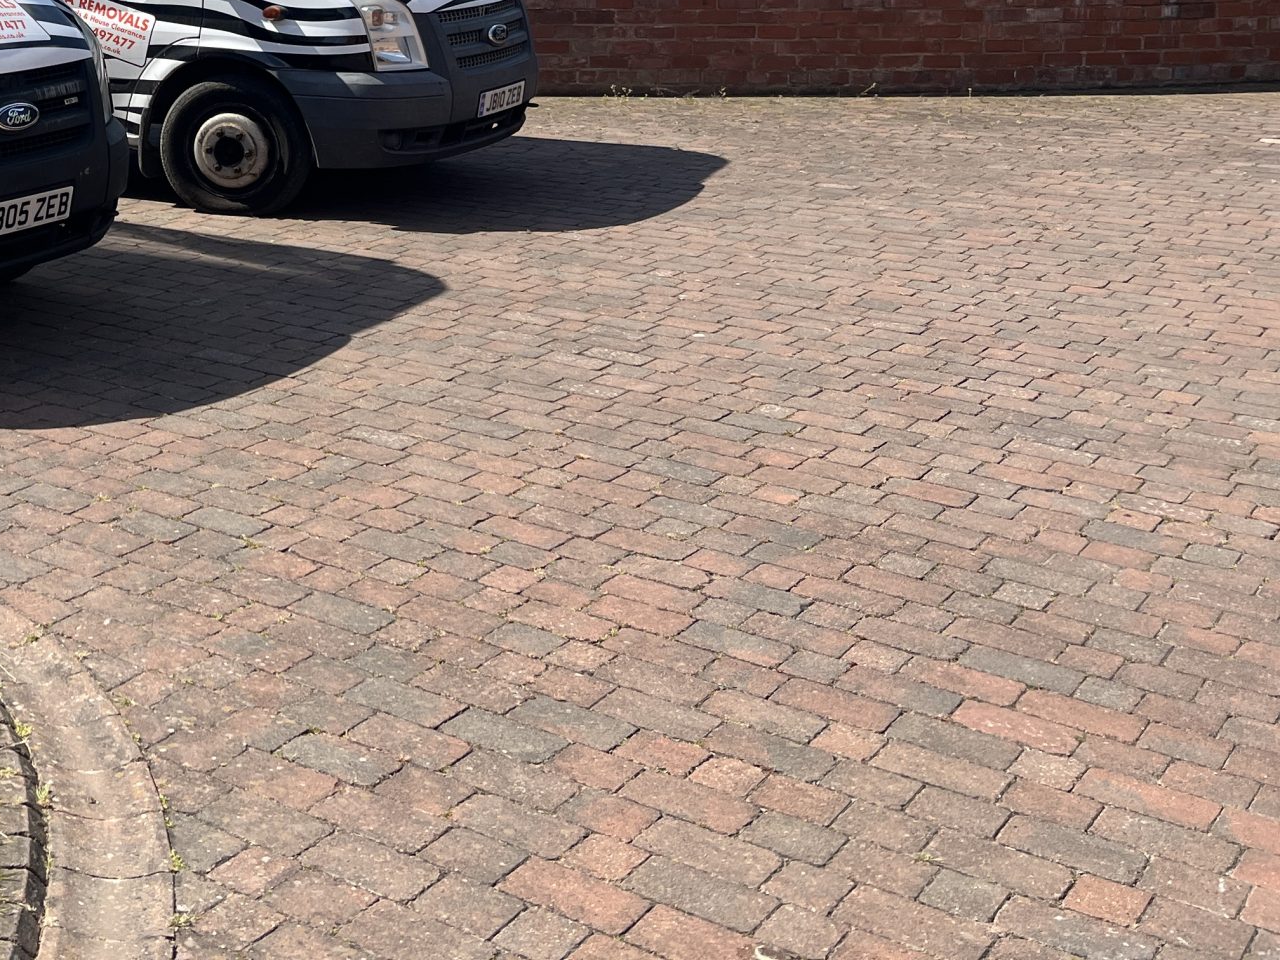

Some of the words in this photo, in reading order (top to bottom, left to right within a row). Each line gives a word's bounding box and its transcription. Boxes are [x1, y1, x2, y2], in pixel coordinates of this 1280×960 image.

[90, 15, 109, 27] House
[111, 23, 146, 40] Clearances
[93, 27, 136, 49] 497477
[486, 91, 506, 111] JB10
[506, 85, 522, 106] ZEB
[6, 107, 32, 126] Ford
[33, 192, 70, 223] ZEB
